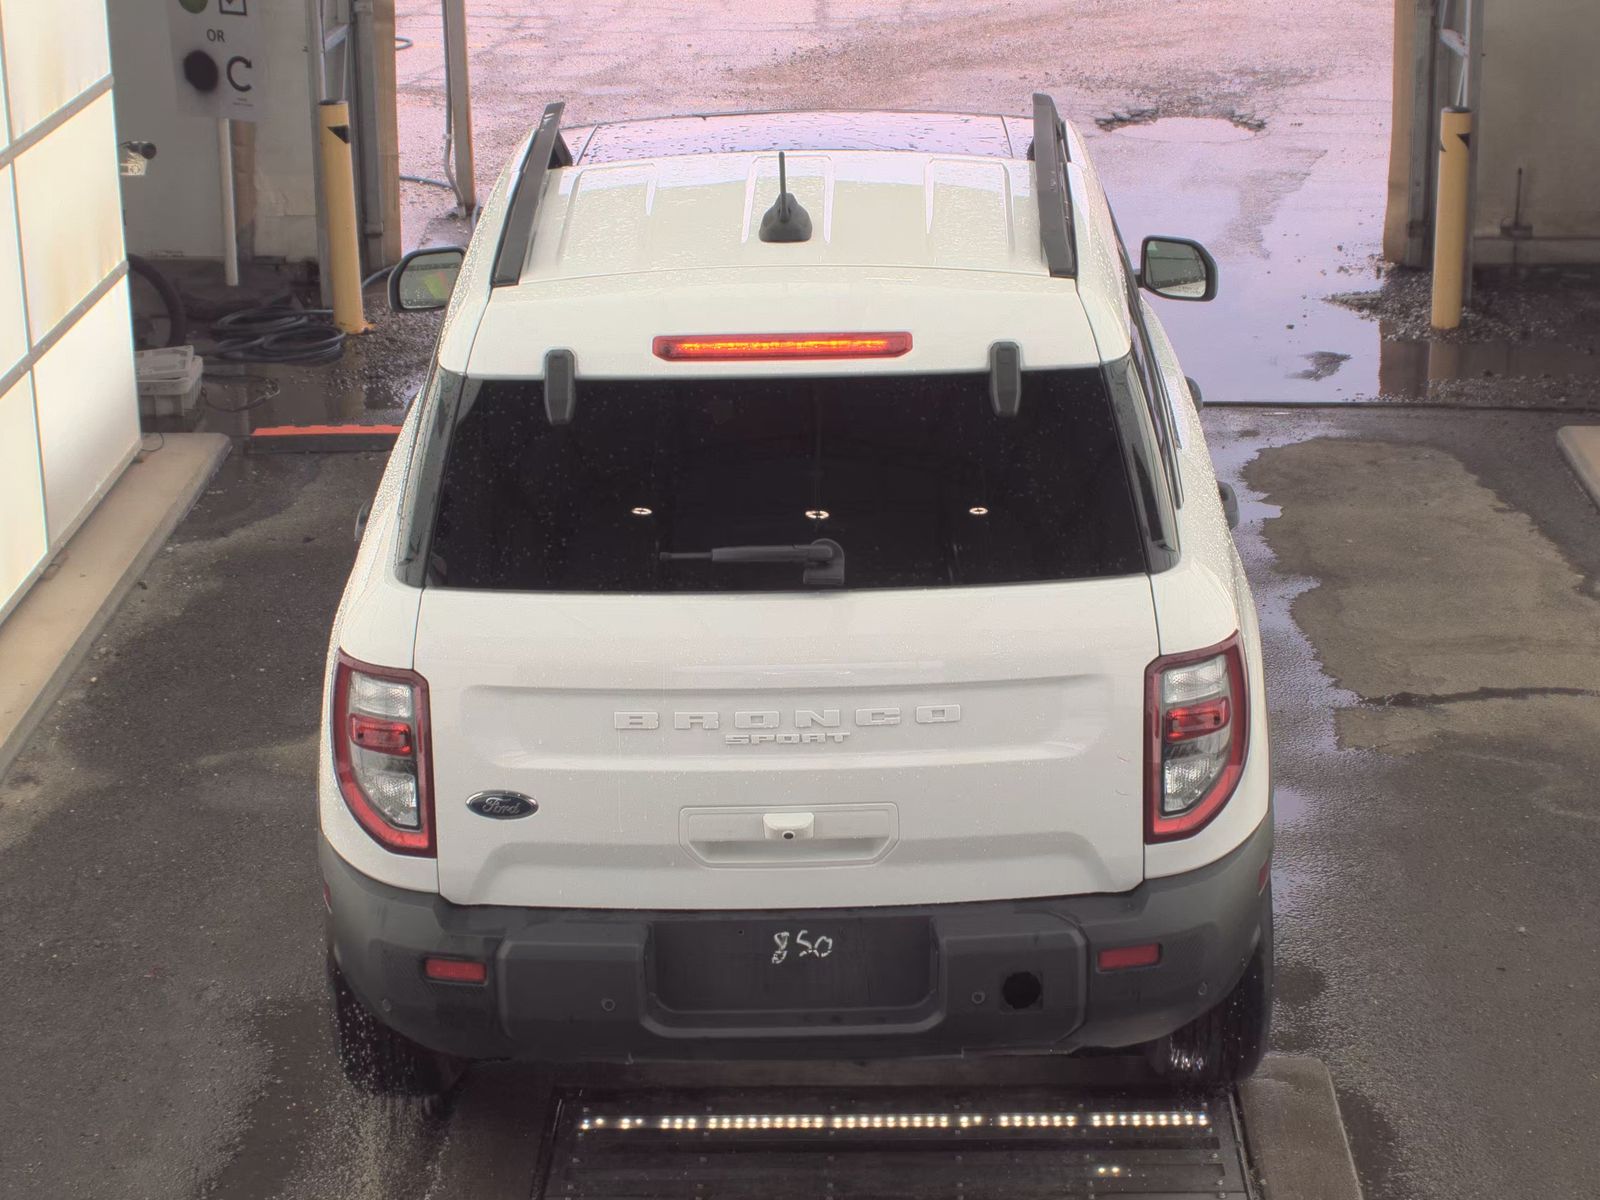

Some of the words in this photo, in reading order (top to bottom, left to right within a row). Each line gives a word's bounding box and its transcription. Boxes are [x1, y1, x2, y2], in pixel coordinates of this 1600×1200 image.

[206, 28, 225, 42] OR
[614, 704, 961, 729] BRONCO
[725, 732, 850, 745] SPORT
[482, 797, 520, 814] Ford
[771, 930, 833, 964] 850
